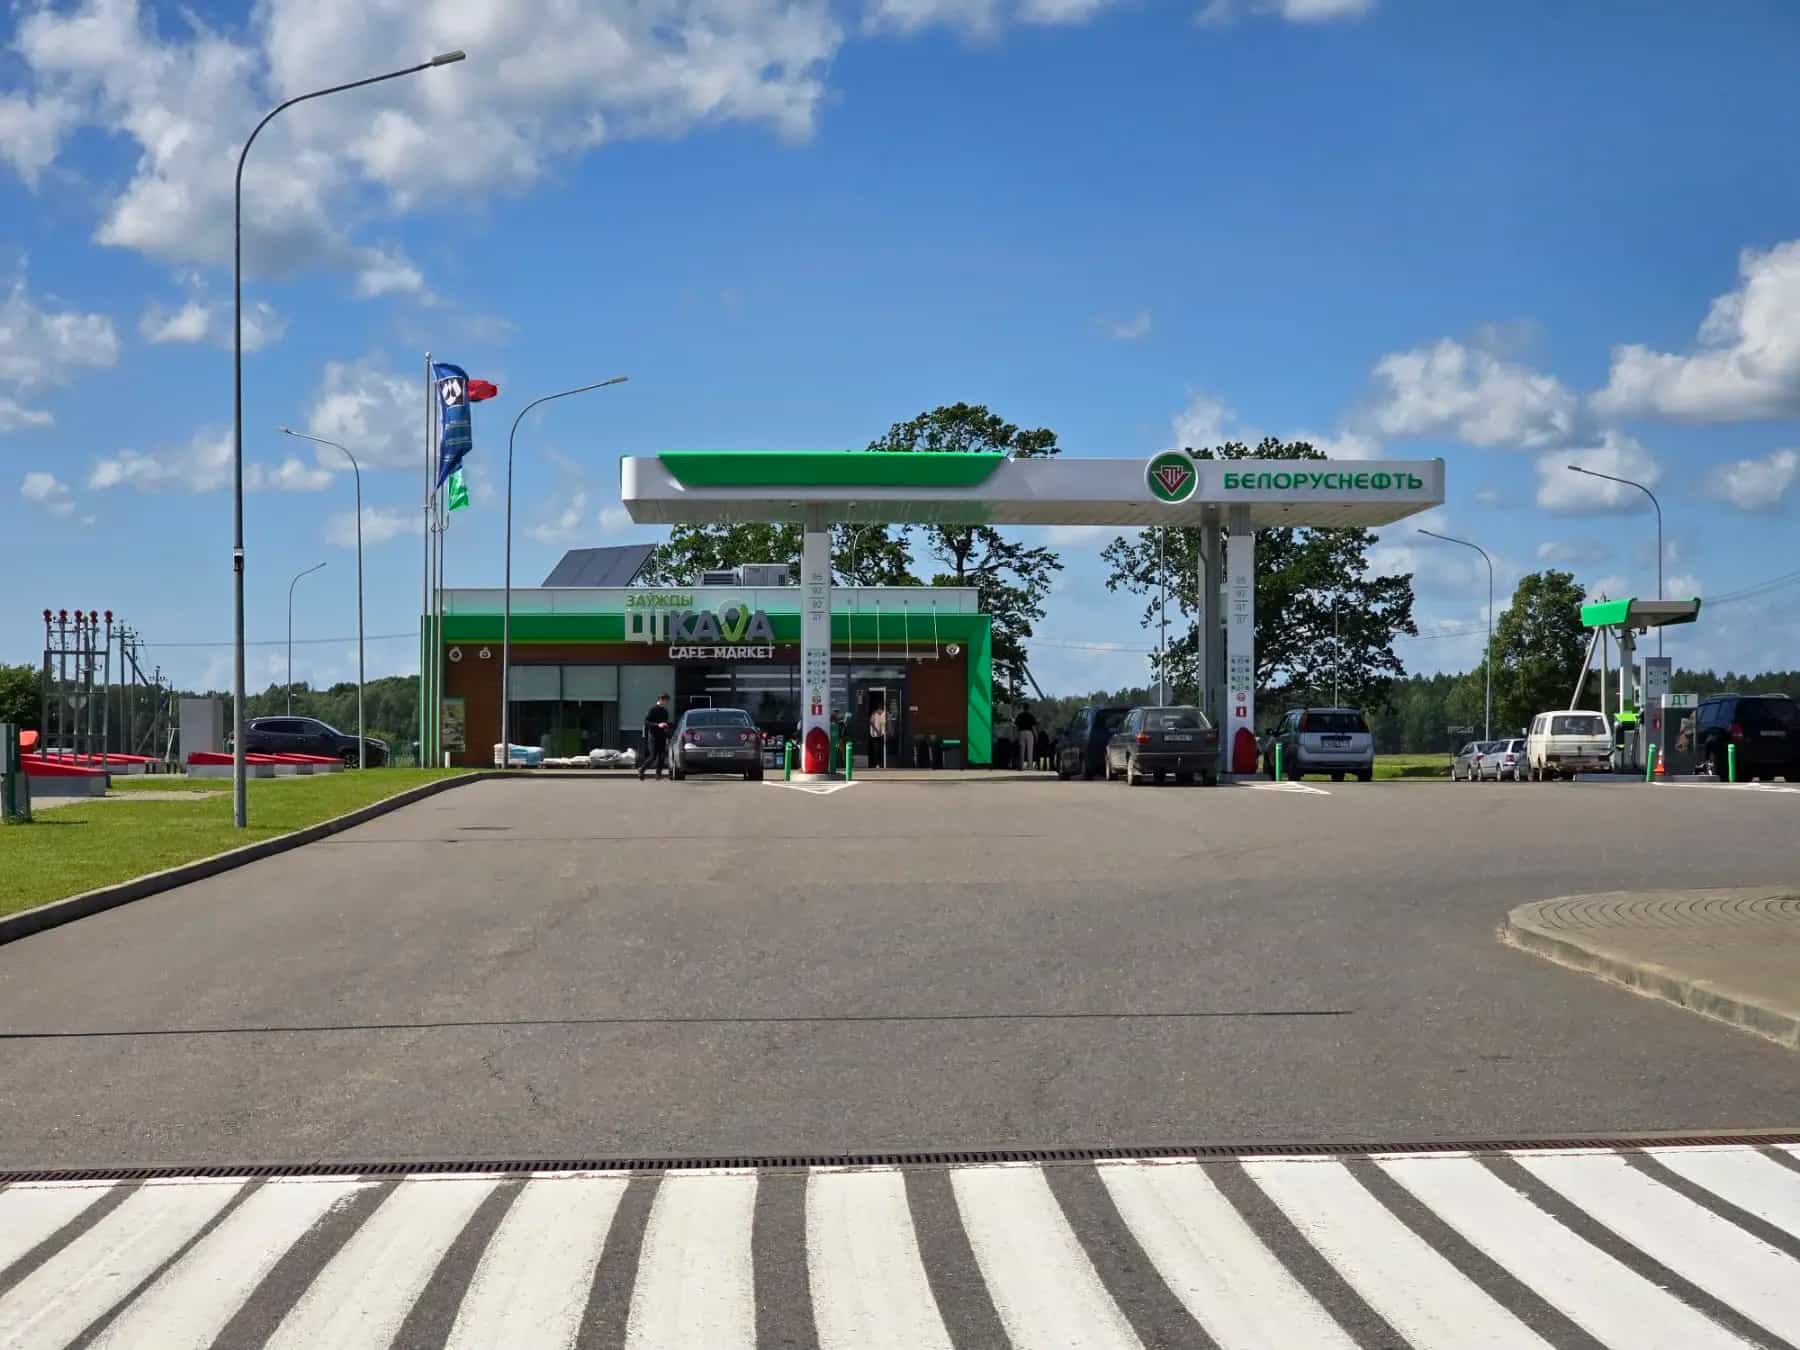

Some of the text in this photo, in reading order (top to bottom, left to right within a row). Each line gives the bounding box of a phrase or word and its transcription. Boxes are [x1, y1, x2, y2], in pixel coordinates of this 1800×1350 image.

[1223, 472, 1423, 490] БЕЛОРУСНЕФТЬ
[668, 646, 776, 659] CAFE MARKET
